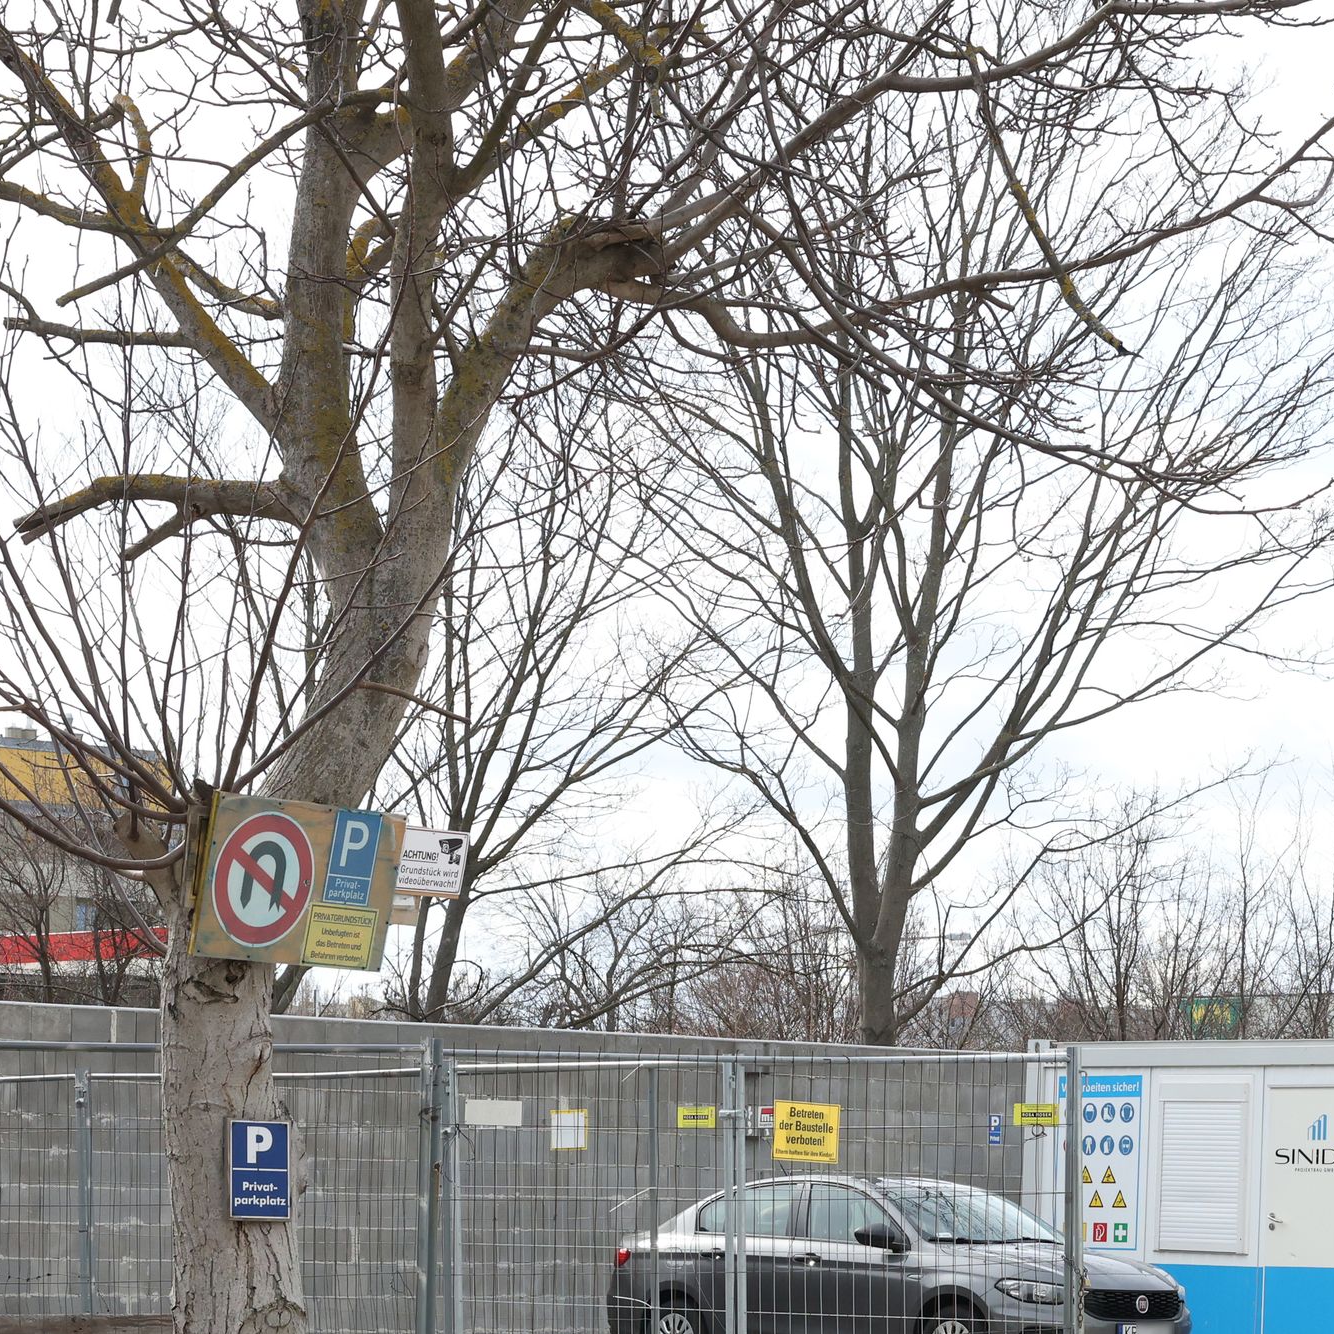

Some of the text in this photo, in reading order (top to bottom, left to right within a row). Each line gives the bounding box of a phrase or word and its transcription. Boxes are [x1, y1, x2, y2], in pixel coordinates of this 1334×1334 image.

[339, 820, 370, 867] P
[402, 849, 440, 861] ACHTUNG!
[400, 864, 459, 878] Grundstück wird
[335, 878, 361, 891] Privat-
[398, 875, 458, 889] videoüberwacht!
[327, 887, 364, 901] parkplatz
[313, 911, 373, 926] PRIVATGRUNDSTÜCK
[321, 927, 361, 939] Unbefugten ist
[315, 939, 362, 951] das Betreten und
[310, 950, 363, 962] Befahren verboten!
[1081, 1080, 1111, 1093] rbeiten
[1112, 1081, 1140, 1093] sicher!
[789, 1106, 824, 1120] Betreten
[779, 1120, 834, 1134] der Baustelle
[991, 1116, 1000, 1130] P
[246, 1126, 273, 1164] P
[785, 1135, 825, 1147] verboten!
[242, 1181, 278, 1192] Privat-
[234, 1194, 286, 1208] parkplatz
